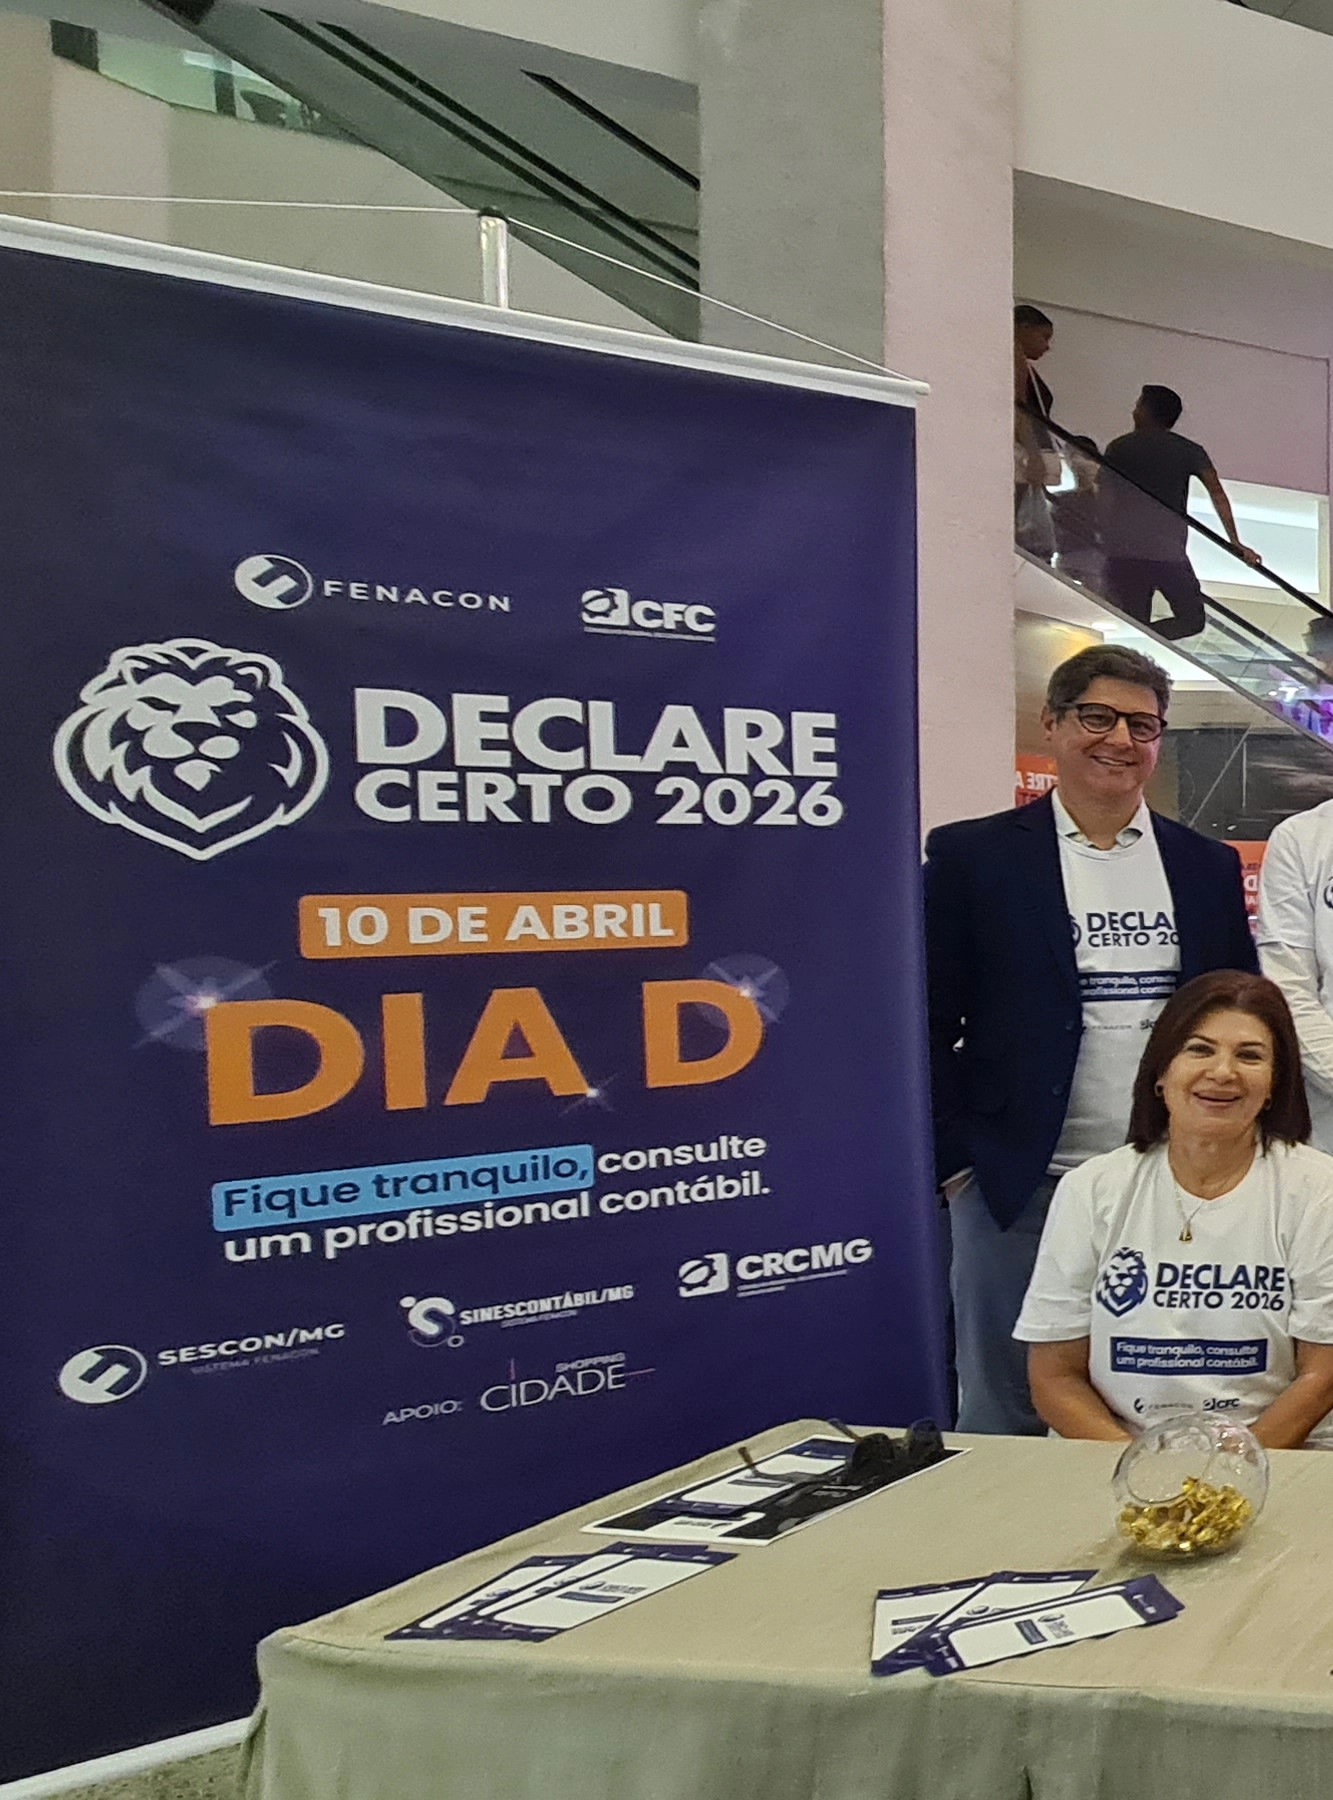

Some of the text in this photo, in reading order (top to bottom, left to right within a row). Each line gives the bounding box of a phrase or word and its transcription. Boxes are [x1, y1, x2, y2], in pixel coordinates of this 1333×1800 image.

[324, 580, 511, 613] FENACON
[631, 599, 717, 632] CFC
[354, 687, 840, 778] DECLARE
[353, 770, 846, 828] CERTO 2026
[317, 902, 676, 947] 10 DE ABRIL
[1088, 931, 1151, 947] CERTO
[204, 979, 766, 1128] DIA D
[224, 1135, 767, 1219] Fique tranquilo, consulte
[224, 1170, 771, 1262] um profissional contábil.
[736, 1238, 873, 1281] CRCMG
[1155, 1262, 1286, 1292] DECLARE
[460, 1285, 634, 1325] SINESCONTÁBIL/MG
[1153, 1290, 1285, 1311] CERTO 2026
[158, 1323, 346, 1366] SESCON/MG
[555, 1352, 626, 1373] SHOPPING
[1116, 1341, 1259, 1359] Fique tranquilo, consulte
[382, 1364, 626, 1425] APOIO: CIDADE
[1216, 1398, 1240, 1409] CFC
